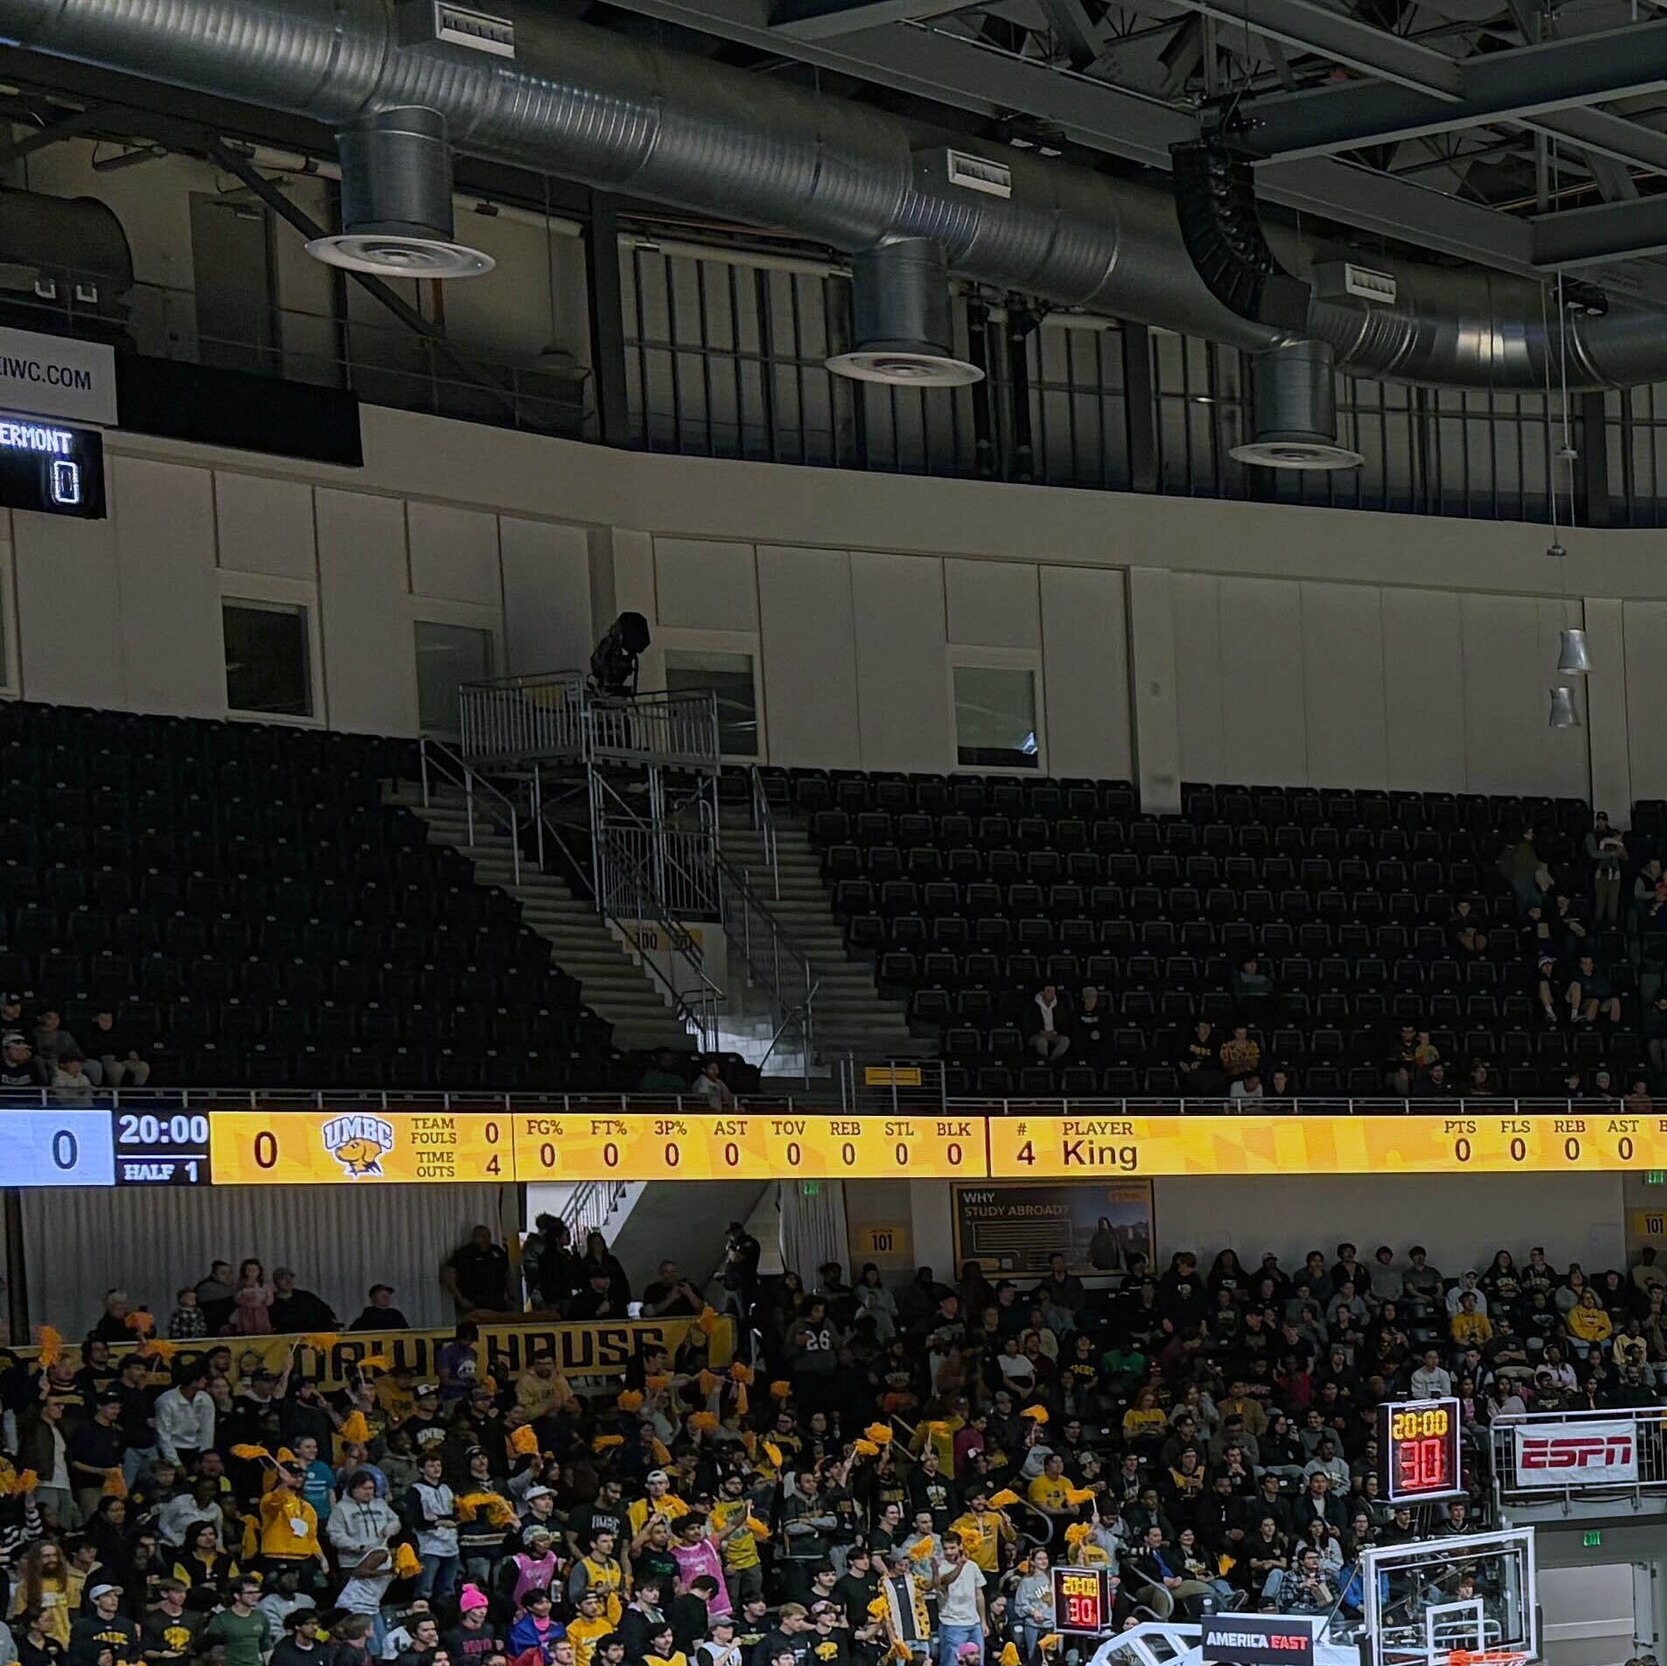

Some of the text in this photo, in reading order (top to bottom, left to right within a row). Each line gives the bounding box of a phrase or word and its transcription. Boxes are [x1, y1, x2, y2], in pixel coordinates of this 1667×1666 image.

[0, 356, 92, 390] IWC.COM
[51, 461, 80, 504] 0
[118, 1113, 209, 1145] 20:00
[323, 1114, 393, 1150] UMBC
[410, 1117, 455, 1130] TEAM
[410, 1121, 499, 1145] FOULS 0
[526, 1119, 972, 1137] FG% FT% 3P% AST TOV REB STL BLK
[1016, 1122, 1027, 1136] #
[1062, 1121, 1134, 1136] PLAYER
[1444, 1120, 1477, 1134] PTS
[1500, 1120, 1531, 1134] FLS
[1553, 1119, 1586, 1133] REB
[1607, 1119, 1640, 1133] AST
[53, 1129, 79, 1170] 0
[253, 1130, 278, 1169] 0
[415, 1151, 455, 1164] TIME
[539, 1142, 963, 1168] 0 0 0 0 0 0 0 0
[1016, 1140, 1036, 1166] 4
[1062, 1139, 1138, 1172] King
[1455, 1137, 1471, 1162] 0
[1510, 1137, 1526, 1162] 0
[1564, 1137, 1580, 1161] 0
[1618, 1136, 1634, 1161] 0
[123, 1160, 198, 1182] HALF 1
[416, 1153, 502, 1178] OUTS 4
[963, 1191, 996, 1204] WHY
[963, 1205, 1005, 1218] STUDY
[1646, 1217, 1665, 1234] 101
[872, 1233, 893, 1251] 101
[487, 1328, 666, 1373] HOUSE
[805, 1329, 831, 1351] 26
[1392, 1408, 1449, 1441] 20:00
[1400, 1437, 1445, 1487] 30
[1520, 1435, 1633, 1470] ESPN
[1062, 1575, 1098, 1597] 20:00
[1067, 1597, 1093, 1623] 30
[1206, 1631, 1309, 1651] AMERICA EAST
